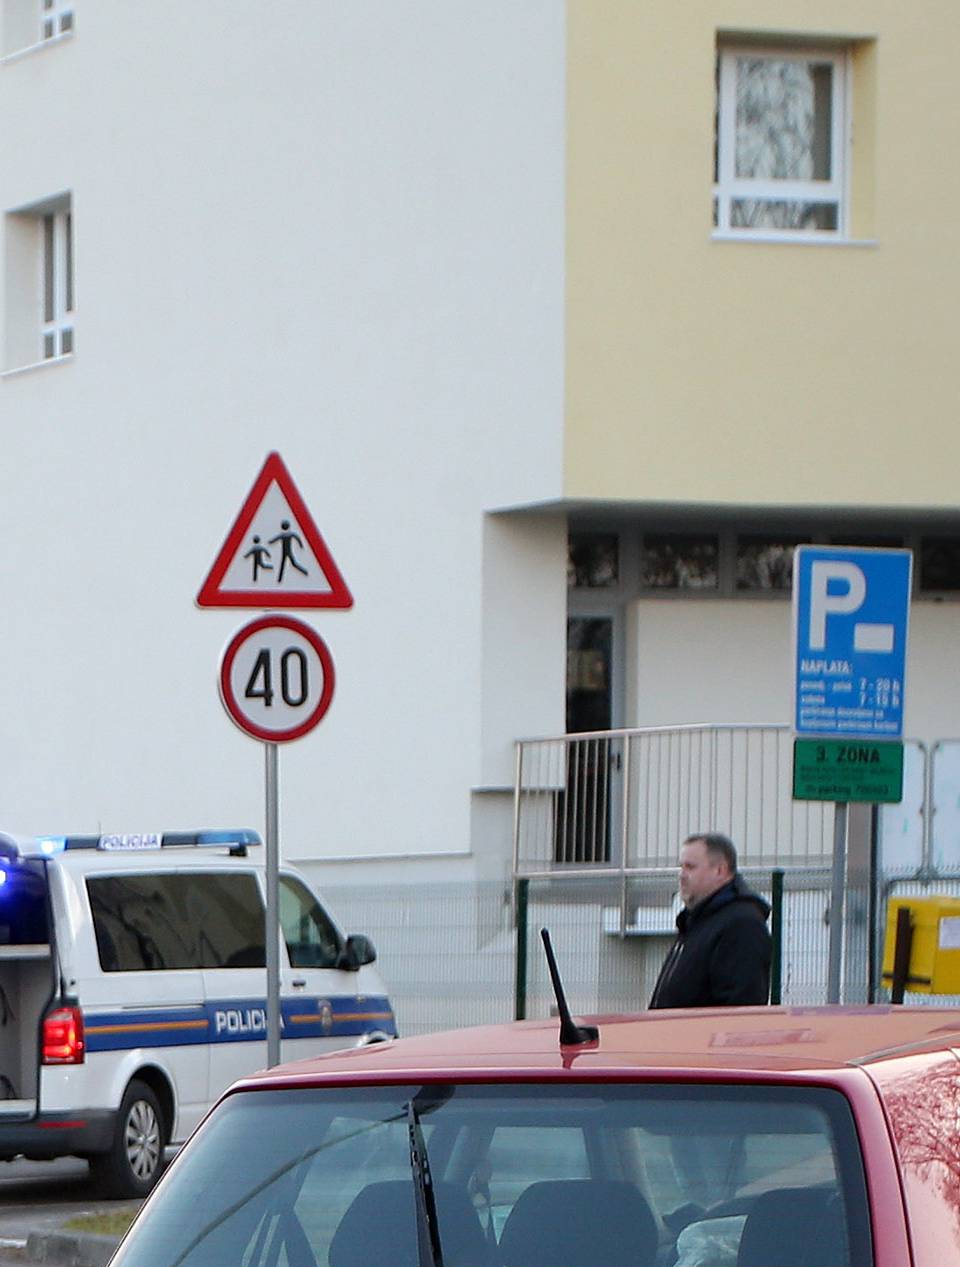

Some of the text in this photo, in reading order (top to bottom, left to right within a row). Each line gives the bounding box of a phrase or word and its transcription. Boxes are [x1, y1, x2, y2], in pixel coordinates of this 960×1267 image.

[809, 560, 867, 651] P
[245, 646, 308, 707] 40
[836, 746, 881, 764] ZONA
[215, 1008, 286, 1033] POLICIA
